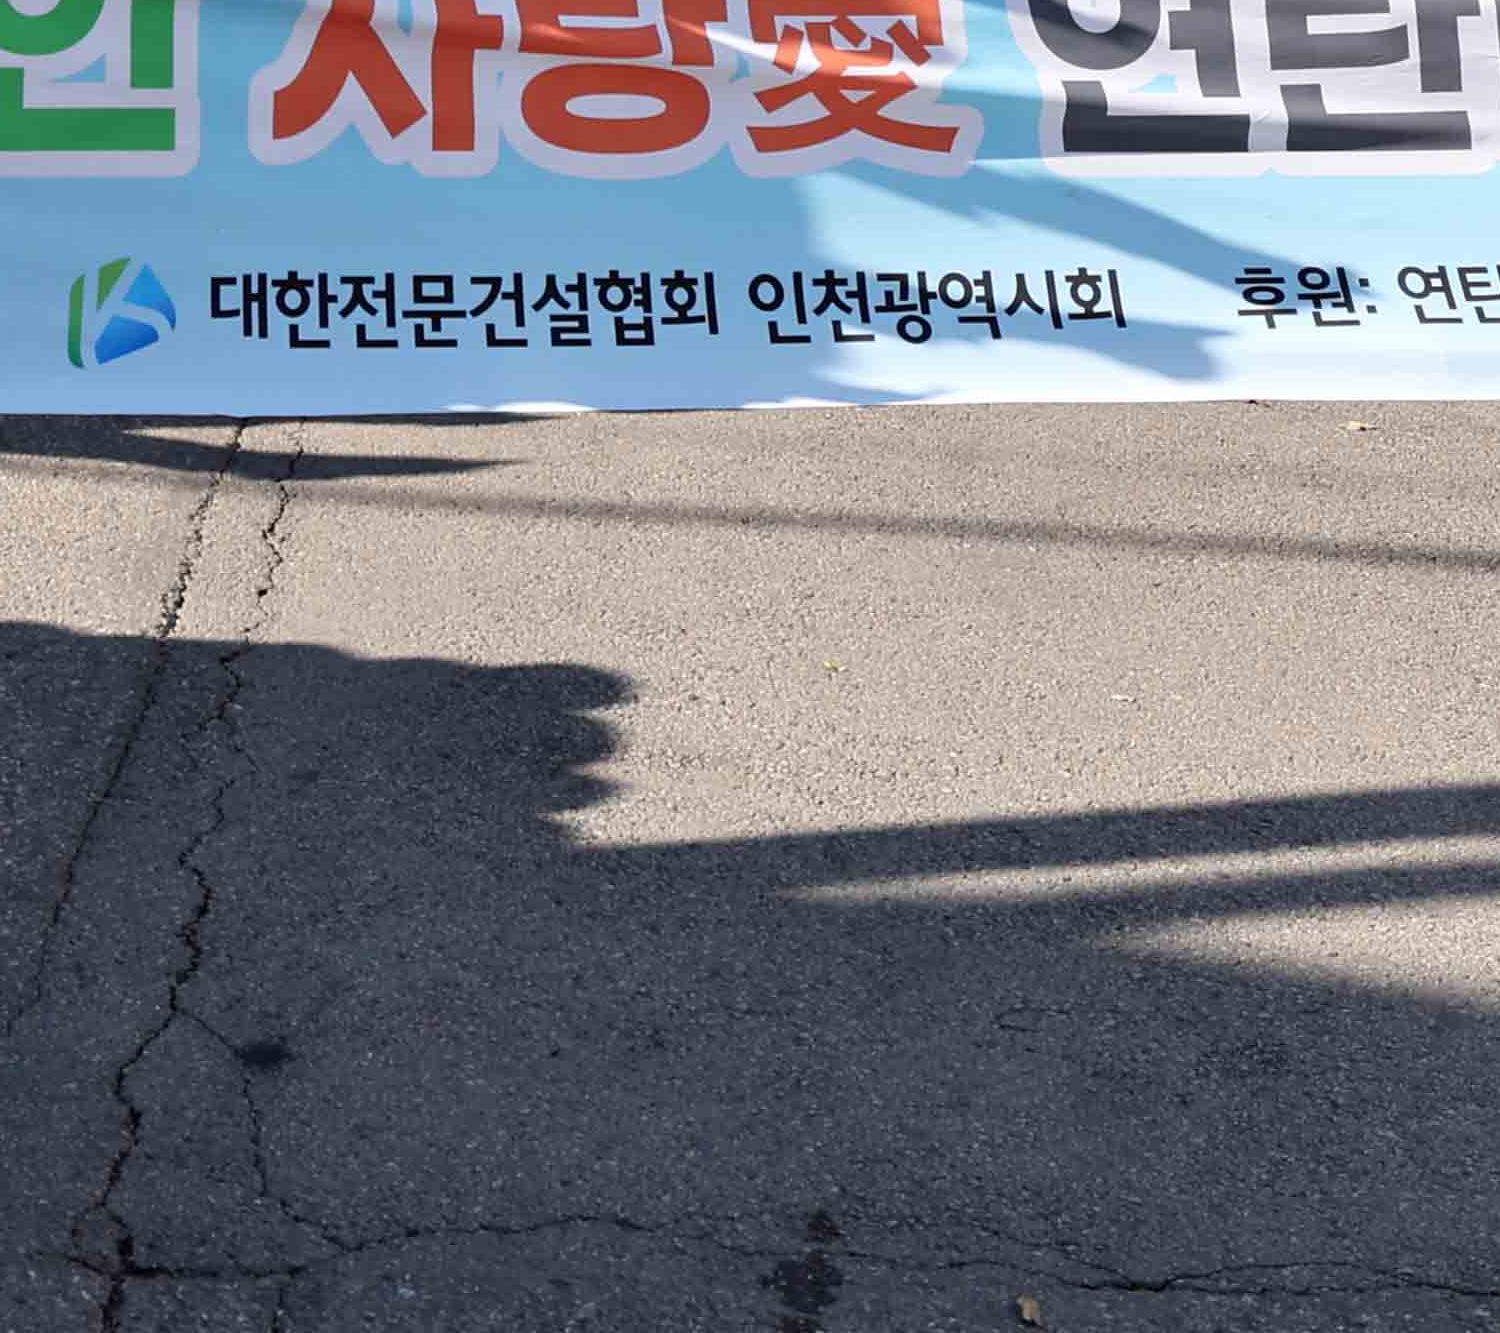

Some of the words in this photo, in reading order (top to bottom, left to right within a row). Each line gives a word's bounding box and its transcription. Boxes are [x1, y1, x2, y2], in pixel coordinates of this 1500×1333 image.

[210, 269, 719, 349] 대한전문건설협회
[748, 267, 1127, 344] 인천광역시회
[1234, 267, 1377, 326] 후원:
